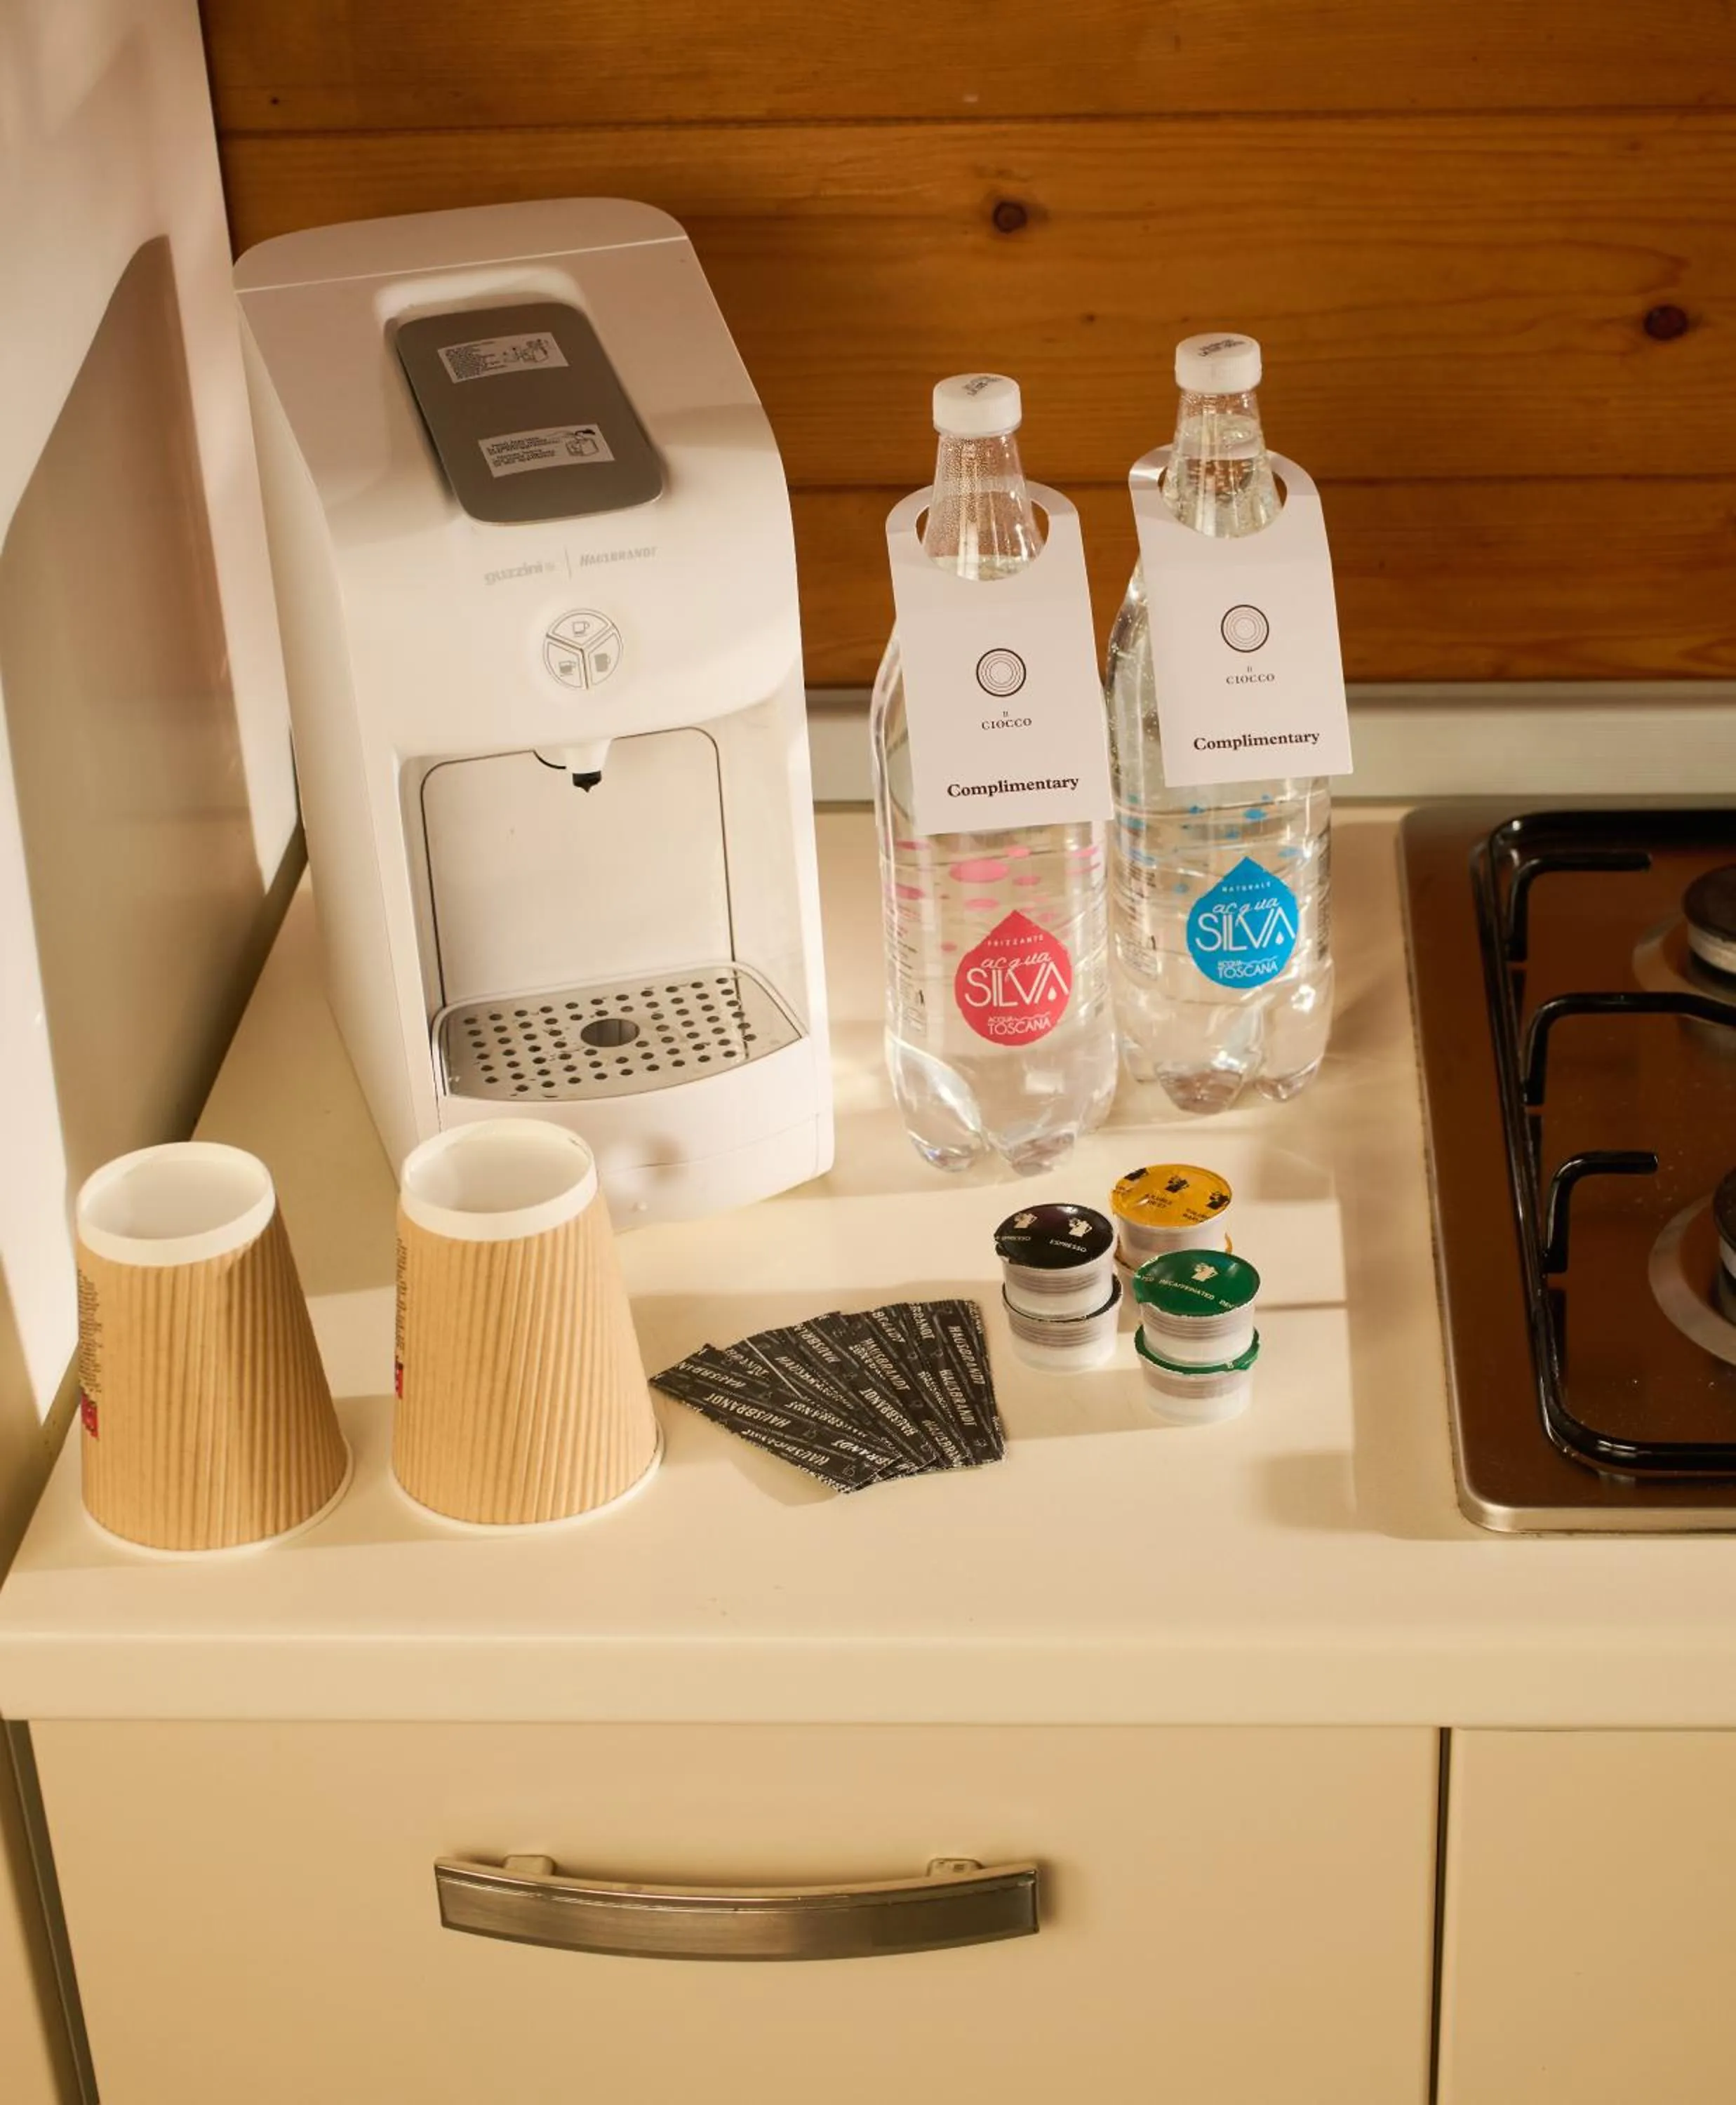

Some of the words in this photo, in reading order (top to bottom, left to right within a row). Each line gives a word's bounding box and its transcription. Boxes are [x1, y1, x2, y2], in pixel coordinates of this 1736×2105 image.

[1226, 674, 1276, 685] CIOCCO
[982, 718, 1032, 730] CIOCCO
[1193, 733, 1320, 751] Complimentary
[947, 777, 1079, 797] Complimentary
[1222, 881, 1271, 893] NATURALE
[1213, 897, 1280, 927] acqua
[1195, 906, 1296, 951] SILVA
[987, 934, 1043, 947] FRIZZANTE
[981, 951, 1052, 982] acqua
[1217, 961, 1278, 978] TOSCANA
[965, 961, 1070, 1007] SILVA
[988, 1017, 1051, 1035] TOSCANA
[1050, 1239, 1087, 1252] ESPRESSO
[1159, 1278, 1215, 1300] DECAFFEINATED
[862, 1337, 911, 1391] HAUSBRANDT
[949, 1325, 985, 1385] HAUSBRANDT
[939, 1370, 977, 1427] HAUSBRANDT
[704, 1392, 792, 1429] HAUSBRANDT
[859, 1387, 919, 1437] HAUSBRANDT
